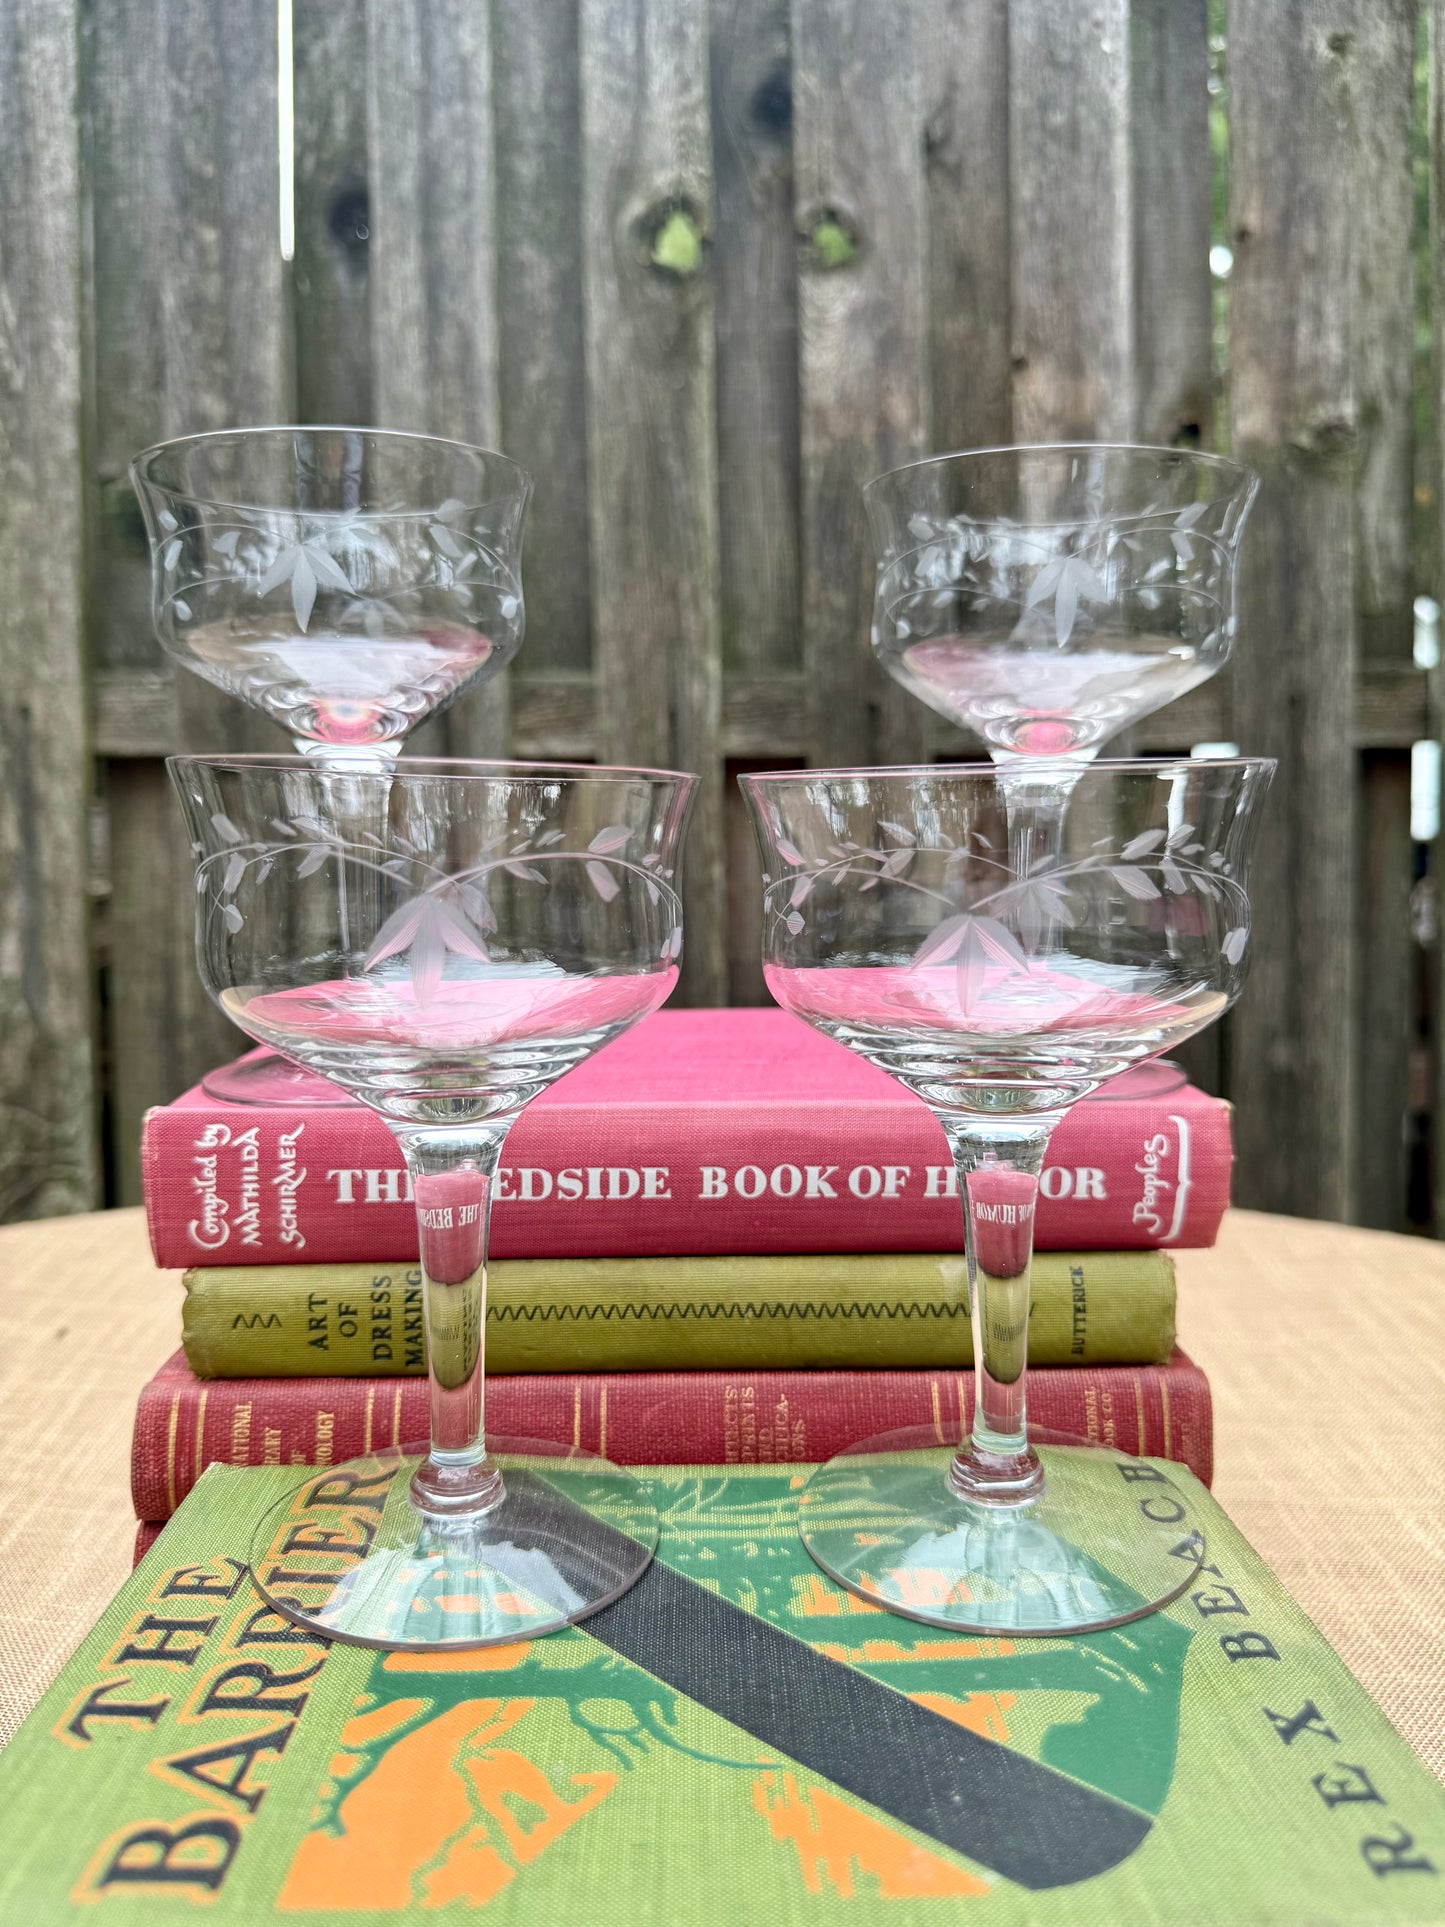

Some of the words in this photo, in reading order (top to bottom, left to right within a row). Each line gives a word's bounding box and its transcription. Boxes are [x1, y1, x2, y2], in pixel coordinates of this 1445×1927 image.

[194, 1123, 232, 1148] by
[491, 1166, 673, 1201] EDSIDE
[699, 1164, 839, 1199] BOOK
[848, 1165, 911, 1198] OF
[923, 1165, 1108, 1200] HOR
[188, 1152, 230, 1249] Compiled
[232, 1125, 263, 1246] MATHILDA
[272, 1122, 307, 1249] SCHIRMER
[1132, 1133, 1172, 1236] Peoples
[307, 1292, 329, 1351] ART
[338, 1302, 358, 1338] OF
[370, 1274, 393, 1362] DRESS
[404, 1269, 425, 1367] MAKING
[1070, 1265, 1087, 1357] BUTTERICK
[315, 1409, 335, 1466] NOLOGY
[1115, 1462, 1282, 1666] BEACH
[50, 1554, 250, 1751] THE
[71, 1461, 400, 1905] BARRIER
[1262, 1699, 1439, 1880] REX
